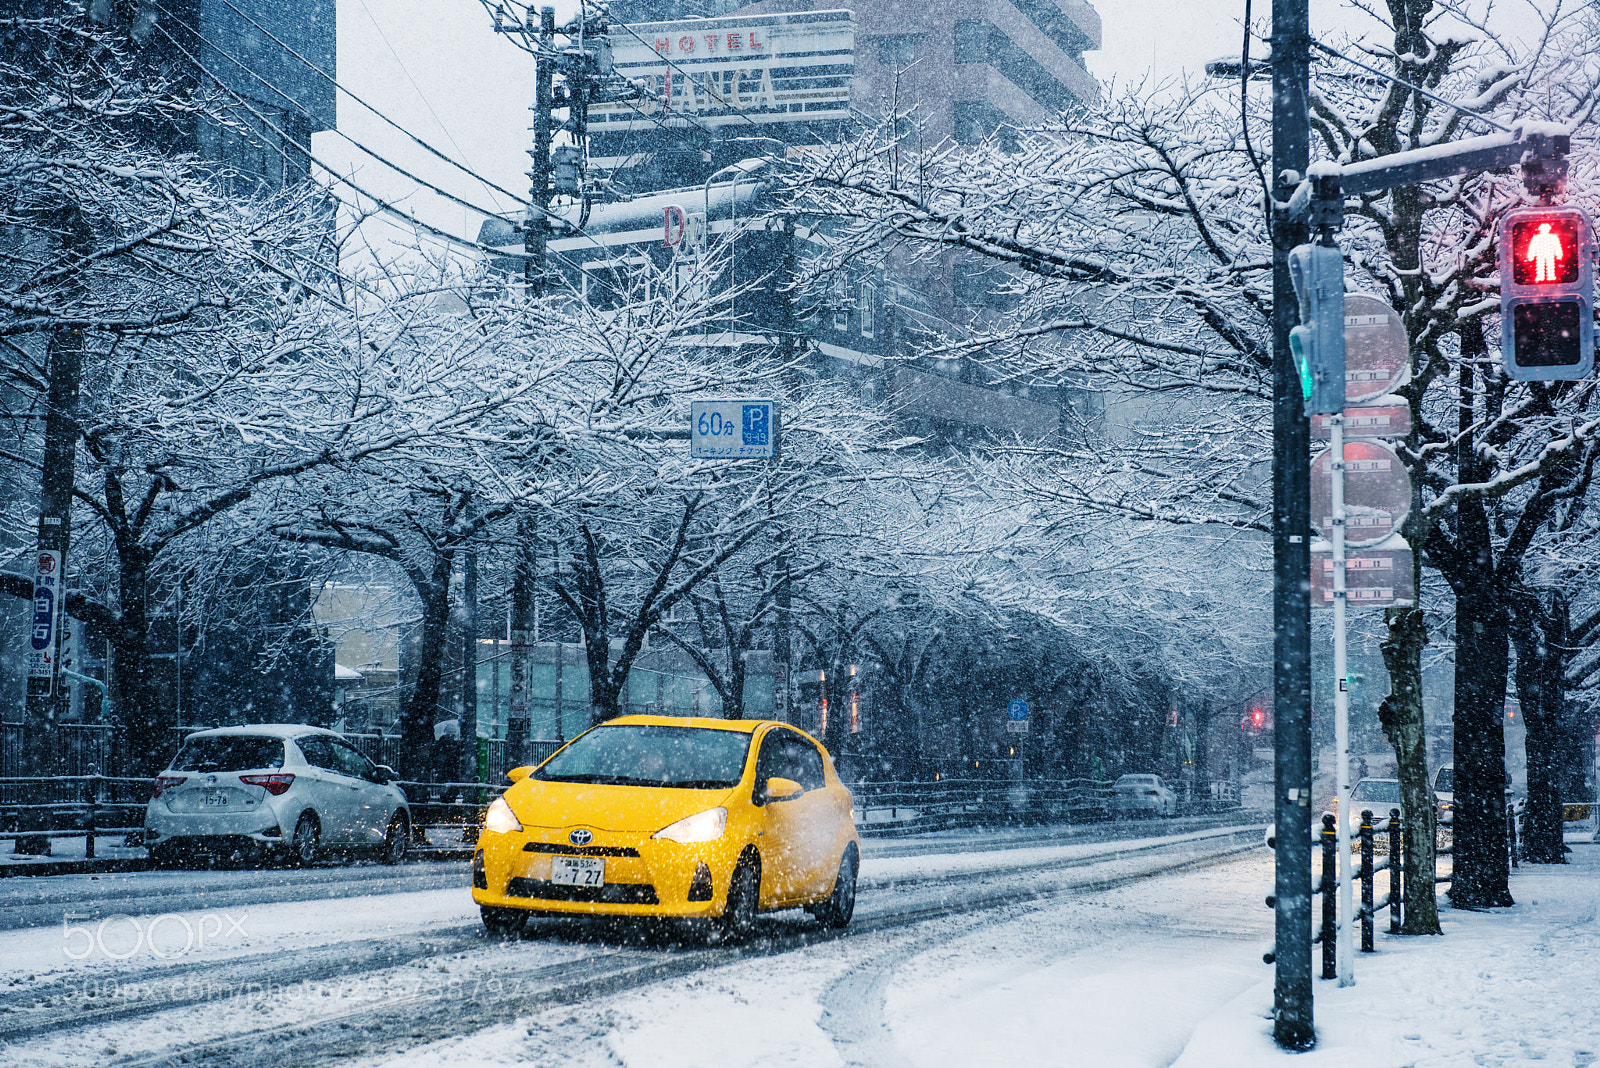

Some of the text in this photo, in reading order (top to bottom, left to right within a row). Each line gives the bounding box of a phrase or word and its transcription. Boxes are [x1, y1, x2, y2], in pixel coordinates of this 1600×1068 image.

[655, 32, 762, 54] HOTEL
[698, 412, 735, 436] 60分
[750, 408, 764, 430] P
[33, 598, 49, 640] 白石
[205, 796, 227, 805] 15-78
